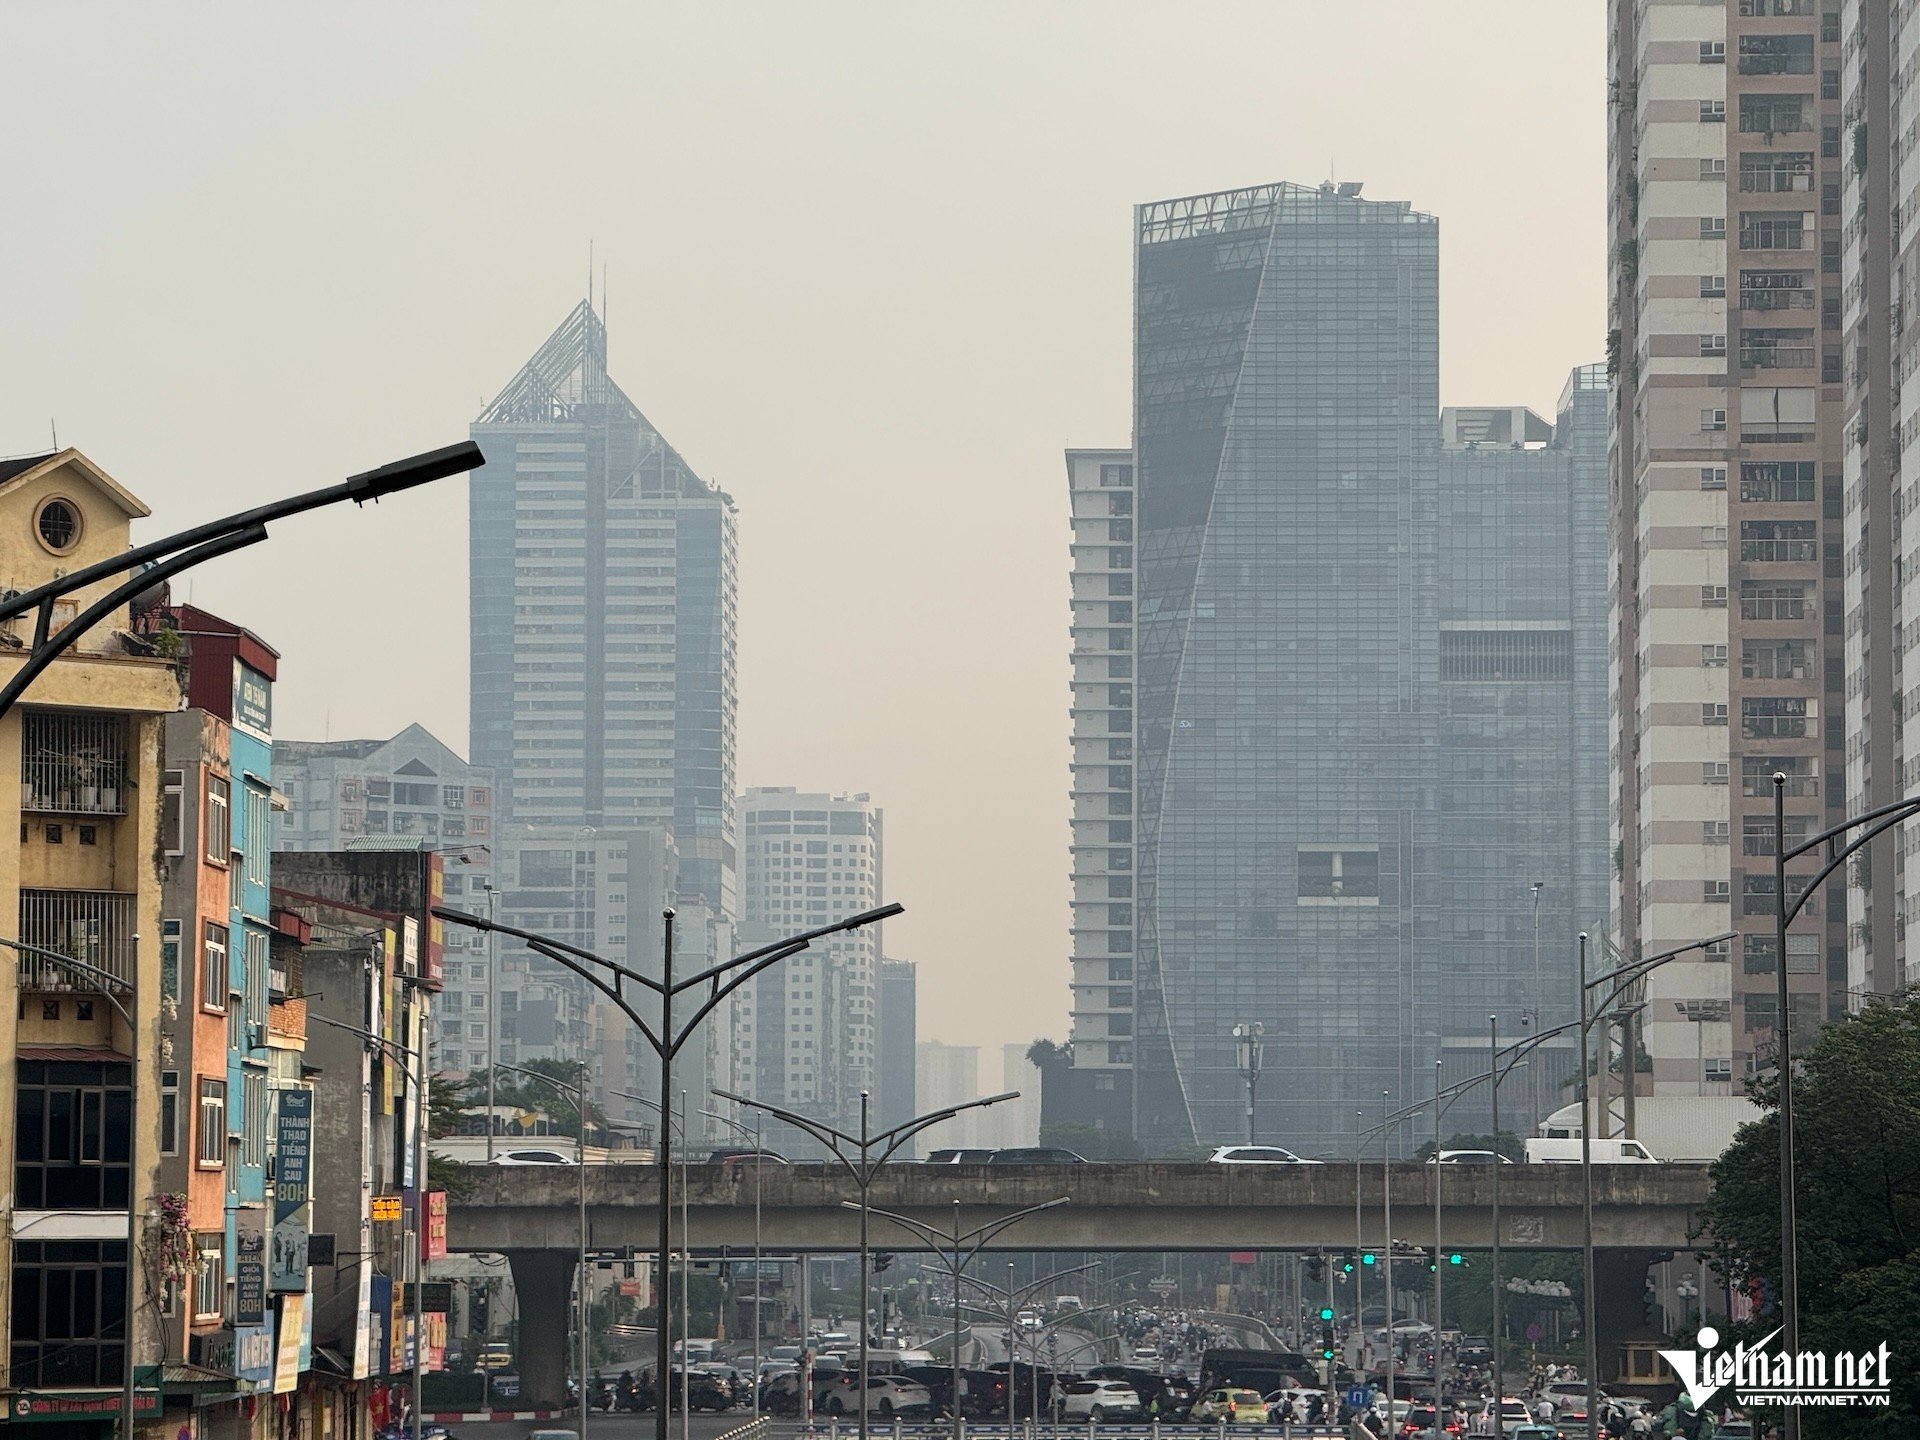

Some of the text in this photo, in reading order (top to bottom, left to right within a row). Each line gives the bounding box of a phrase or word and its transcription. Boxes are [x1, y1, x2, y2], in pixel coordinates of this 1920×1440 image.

[280, 1114, 310, 1128] THÀNH
[281, 1140, 307, 1156] TIẾNG
[284, 1158, 303, 1168] ANH
[284, 1170, 302, 1181] SAU
[278, 1183, 308, 1201] 80H
[240, 1299, 262, 1313] 80H
